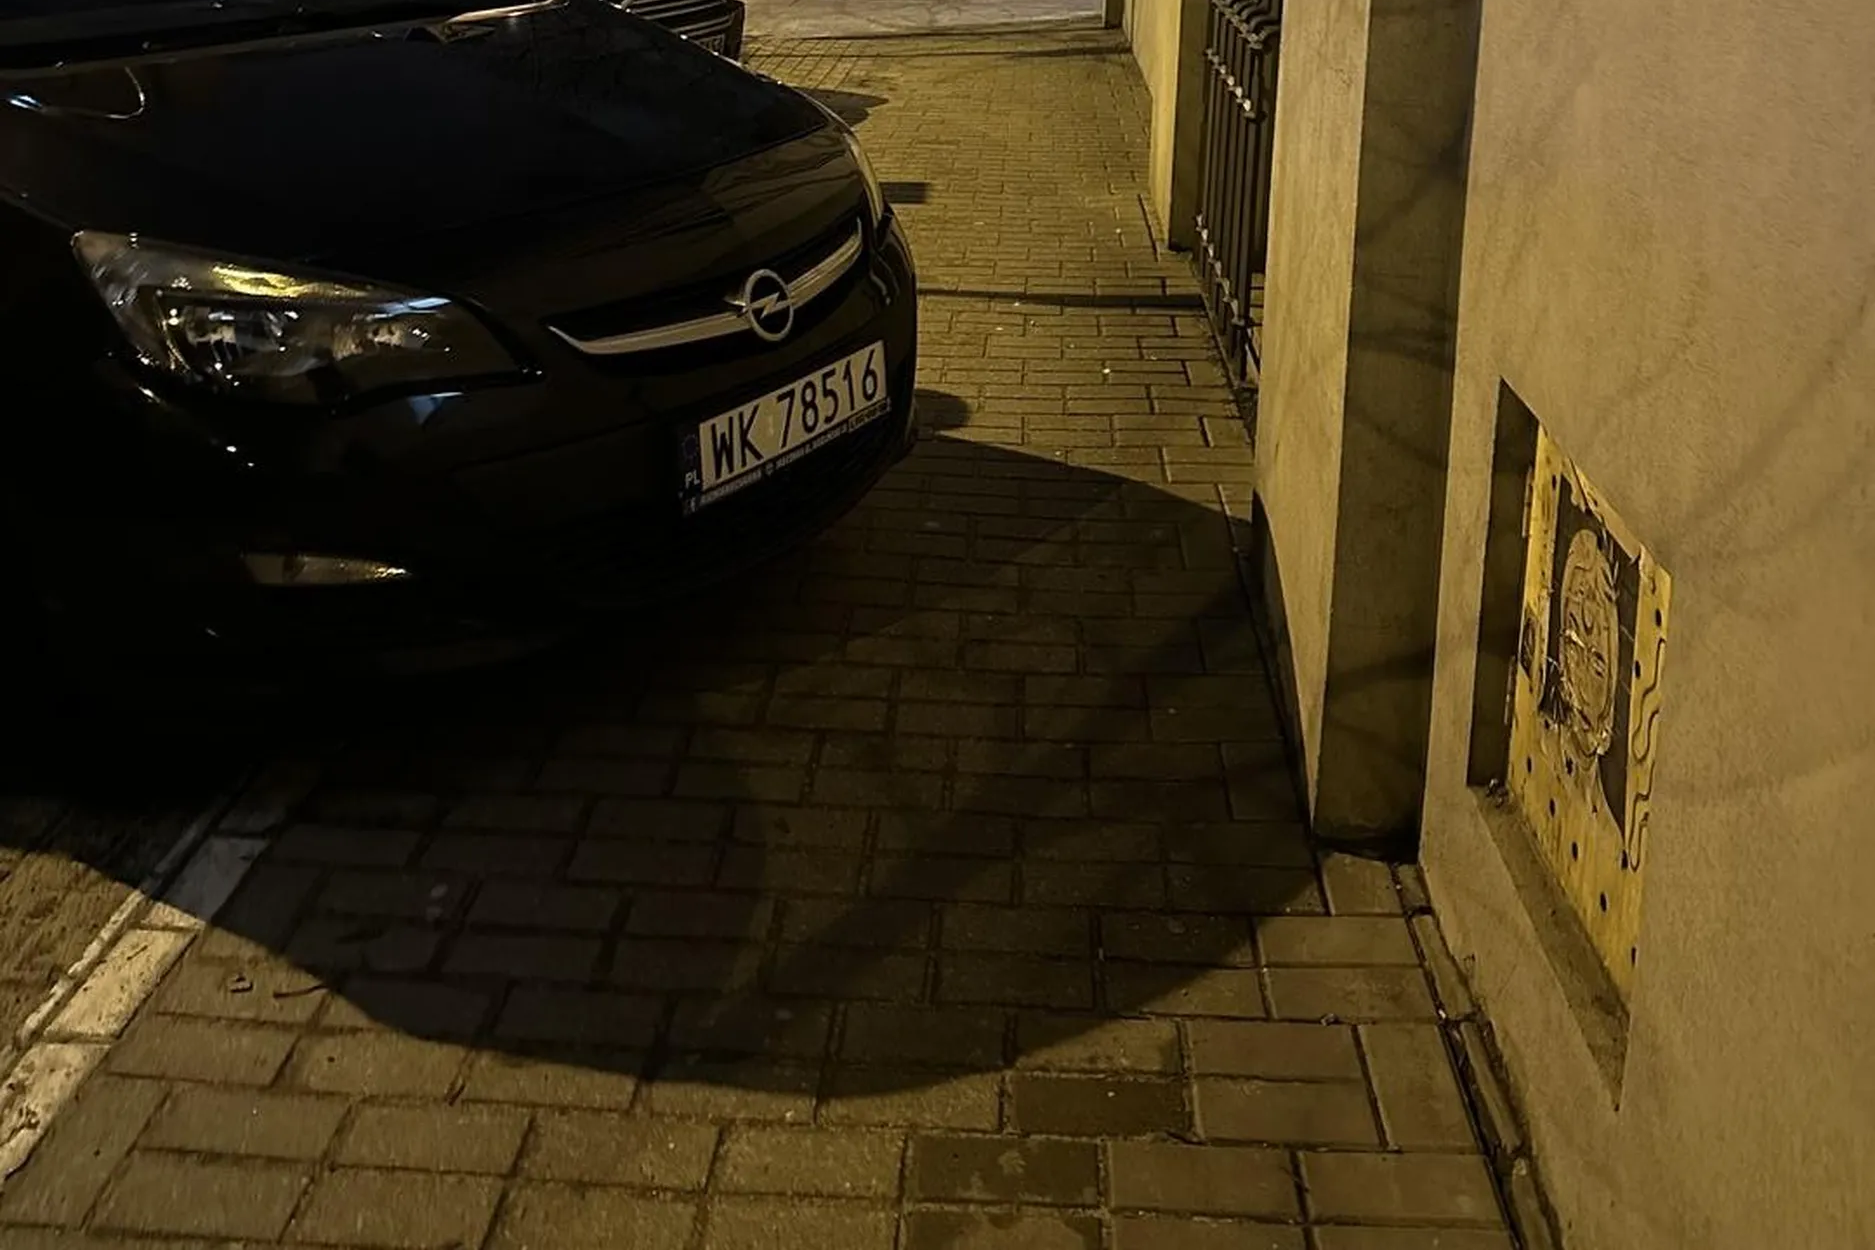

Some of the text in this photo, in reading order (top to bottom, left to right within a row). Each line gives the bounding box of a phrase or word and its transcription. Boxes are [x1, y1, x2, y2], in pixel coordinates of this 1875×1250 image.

[711, 405, 764, 480] WK
[776, 349, 878, 449] 78516
[685, 468, 700, 489] PL
